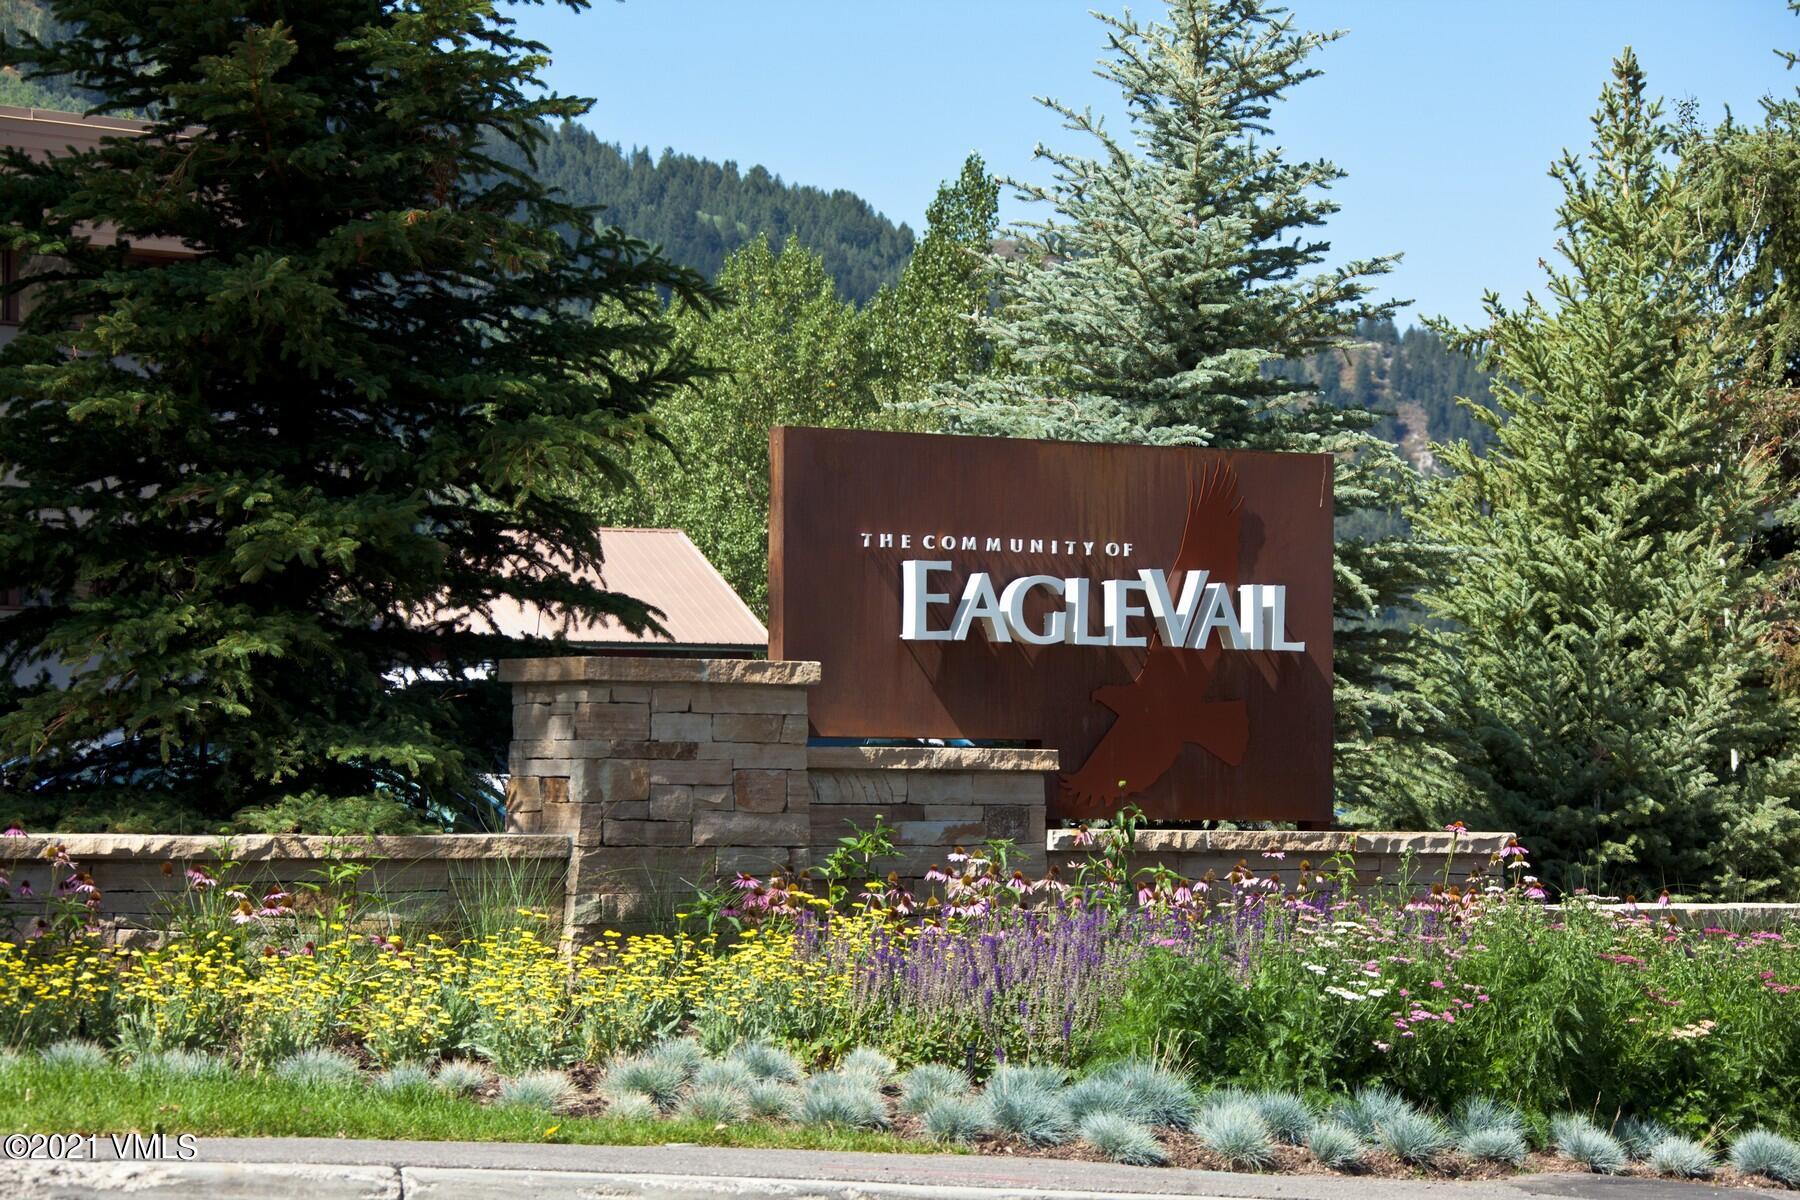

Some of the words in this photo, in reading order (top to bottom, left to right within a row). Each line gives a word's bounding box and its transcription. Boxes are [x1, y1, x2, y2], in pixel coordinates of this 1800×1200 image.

[860, 533, 911, 548] THE
[922, 535, 1095, 556] COMMUNITY
[1105, 542, 1134, 557] OF
